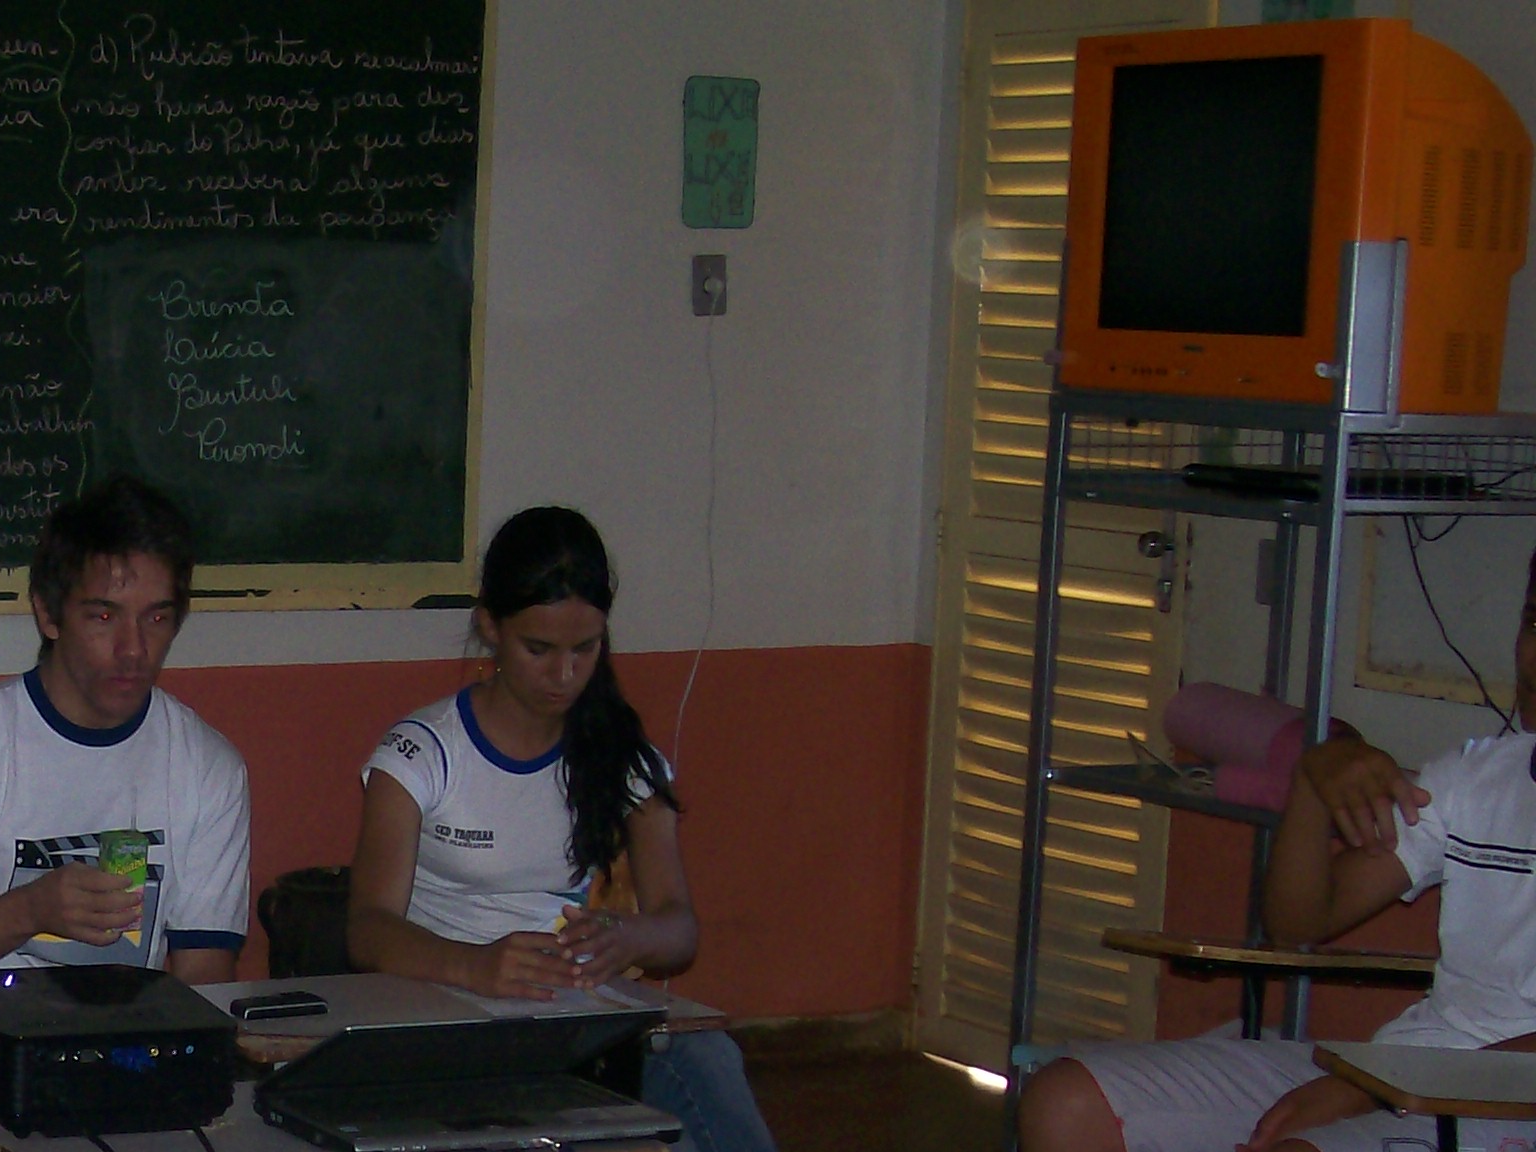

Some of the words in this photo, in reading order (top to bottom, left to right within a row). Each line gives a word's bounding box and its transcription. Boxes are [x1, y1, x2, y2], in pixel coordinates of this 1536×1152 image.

[71, 92, 140, 119] não
[332, 91, 404, 128] para
[353, 132, 405, 171] que
[262, 196, 300, 227] da
